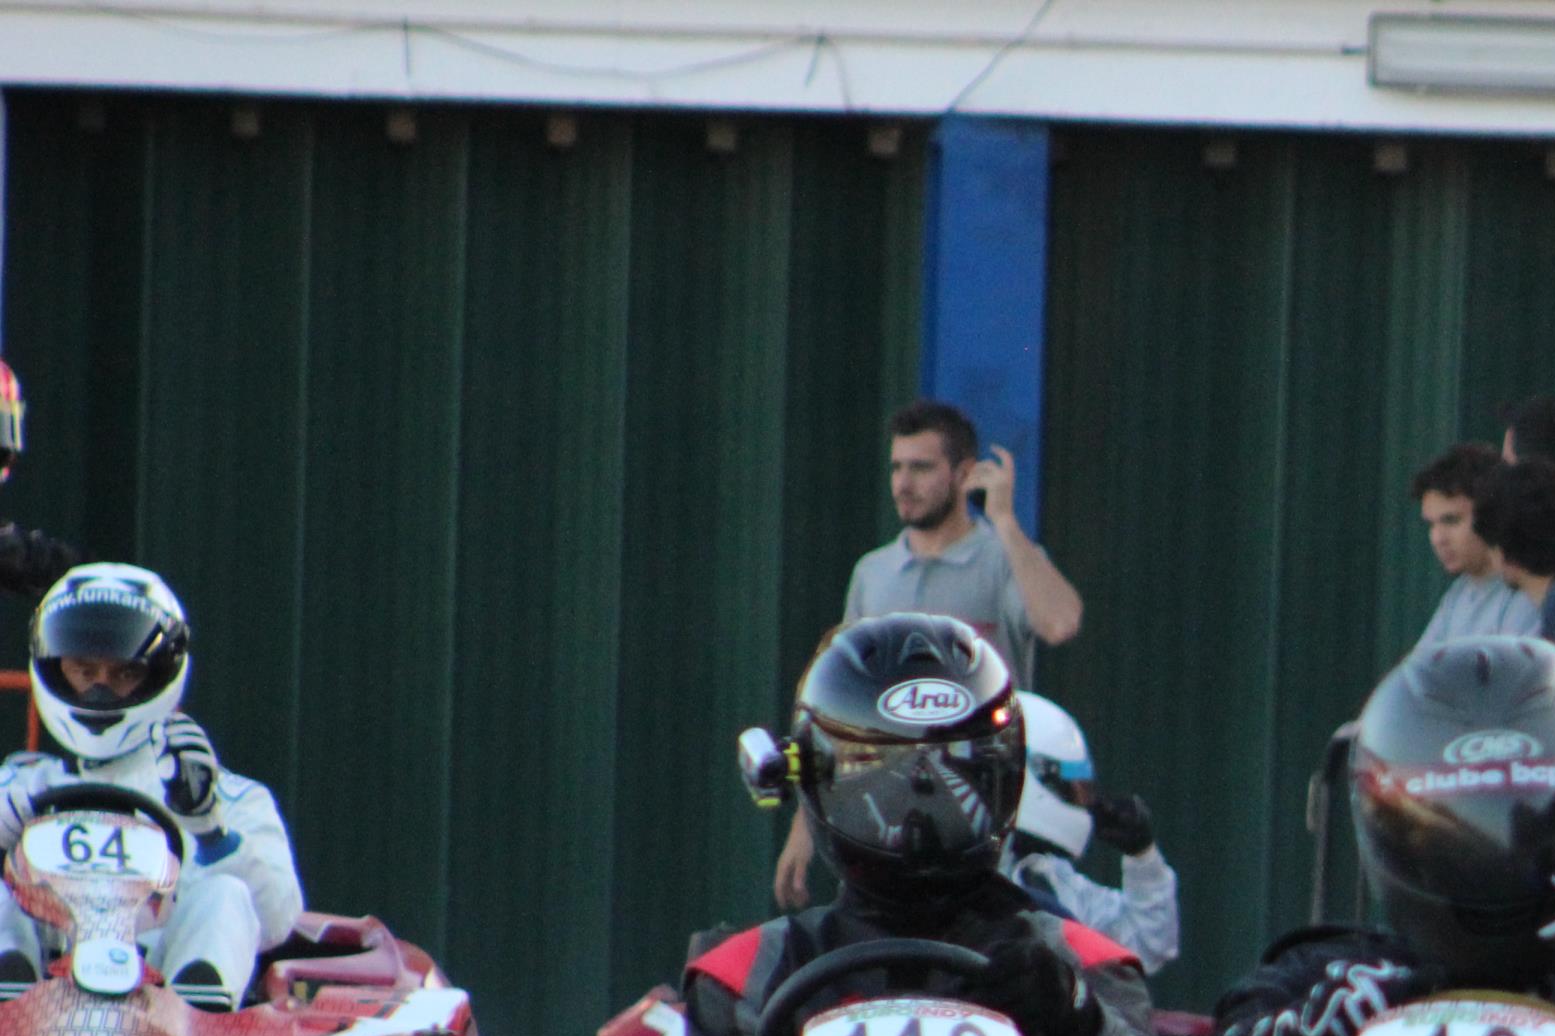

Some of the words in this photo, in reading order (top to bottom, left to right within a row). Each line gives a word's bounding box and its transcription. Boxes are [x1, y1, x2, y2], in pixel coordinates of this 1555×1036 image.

[883, 686, 960, 710] Arai
[1405, 768, 1505, 794] clube
[62, 822, 131, 873] 64
